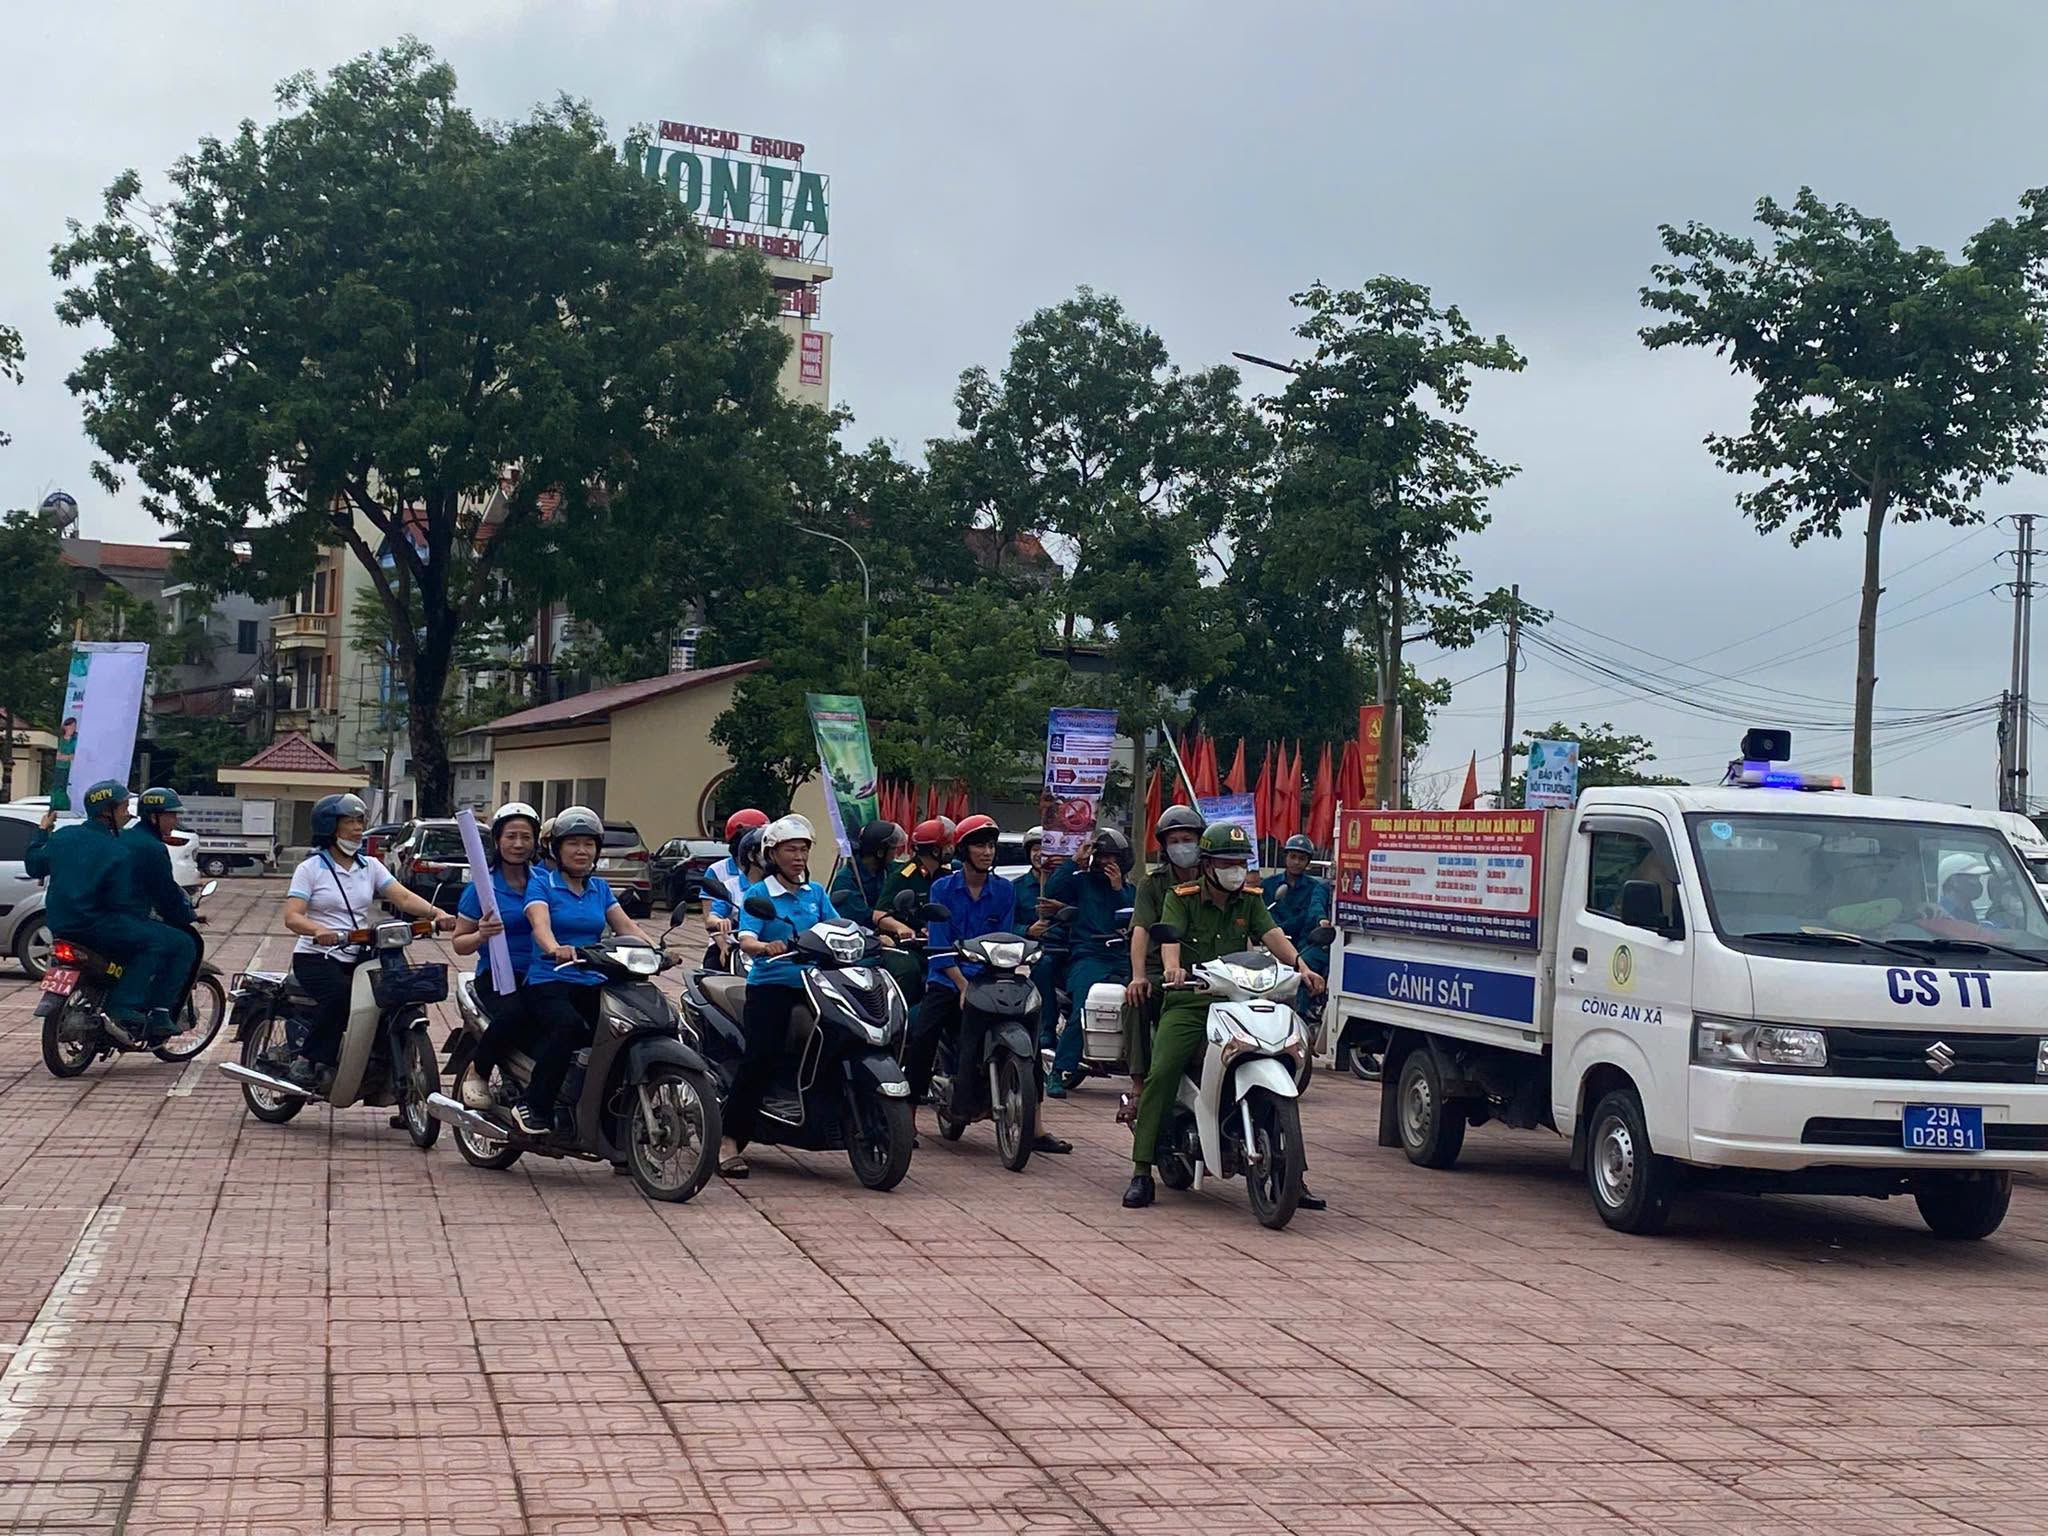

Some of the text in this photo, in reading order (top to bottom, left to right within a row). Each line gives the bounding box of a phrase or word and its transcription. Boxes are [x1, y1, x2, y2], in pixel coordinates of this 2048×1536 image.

[751, 136, 804, 160] GROUP
[1388, 964, 1474, 1008] CẢNH SÁT
[1887, 968, 1992, 1008] CS TT
[1582, 996, 1663, 1025] CÔNG AN XÃ
[1927, 1108, 1960, 1127] 29A
[1913, 1128, 1974, 1148] 028.91
